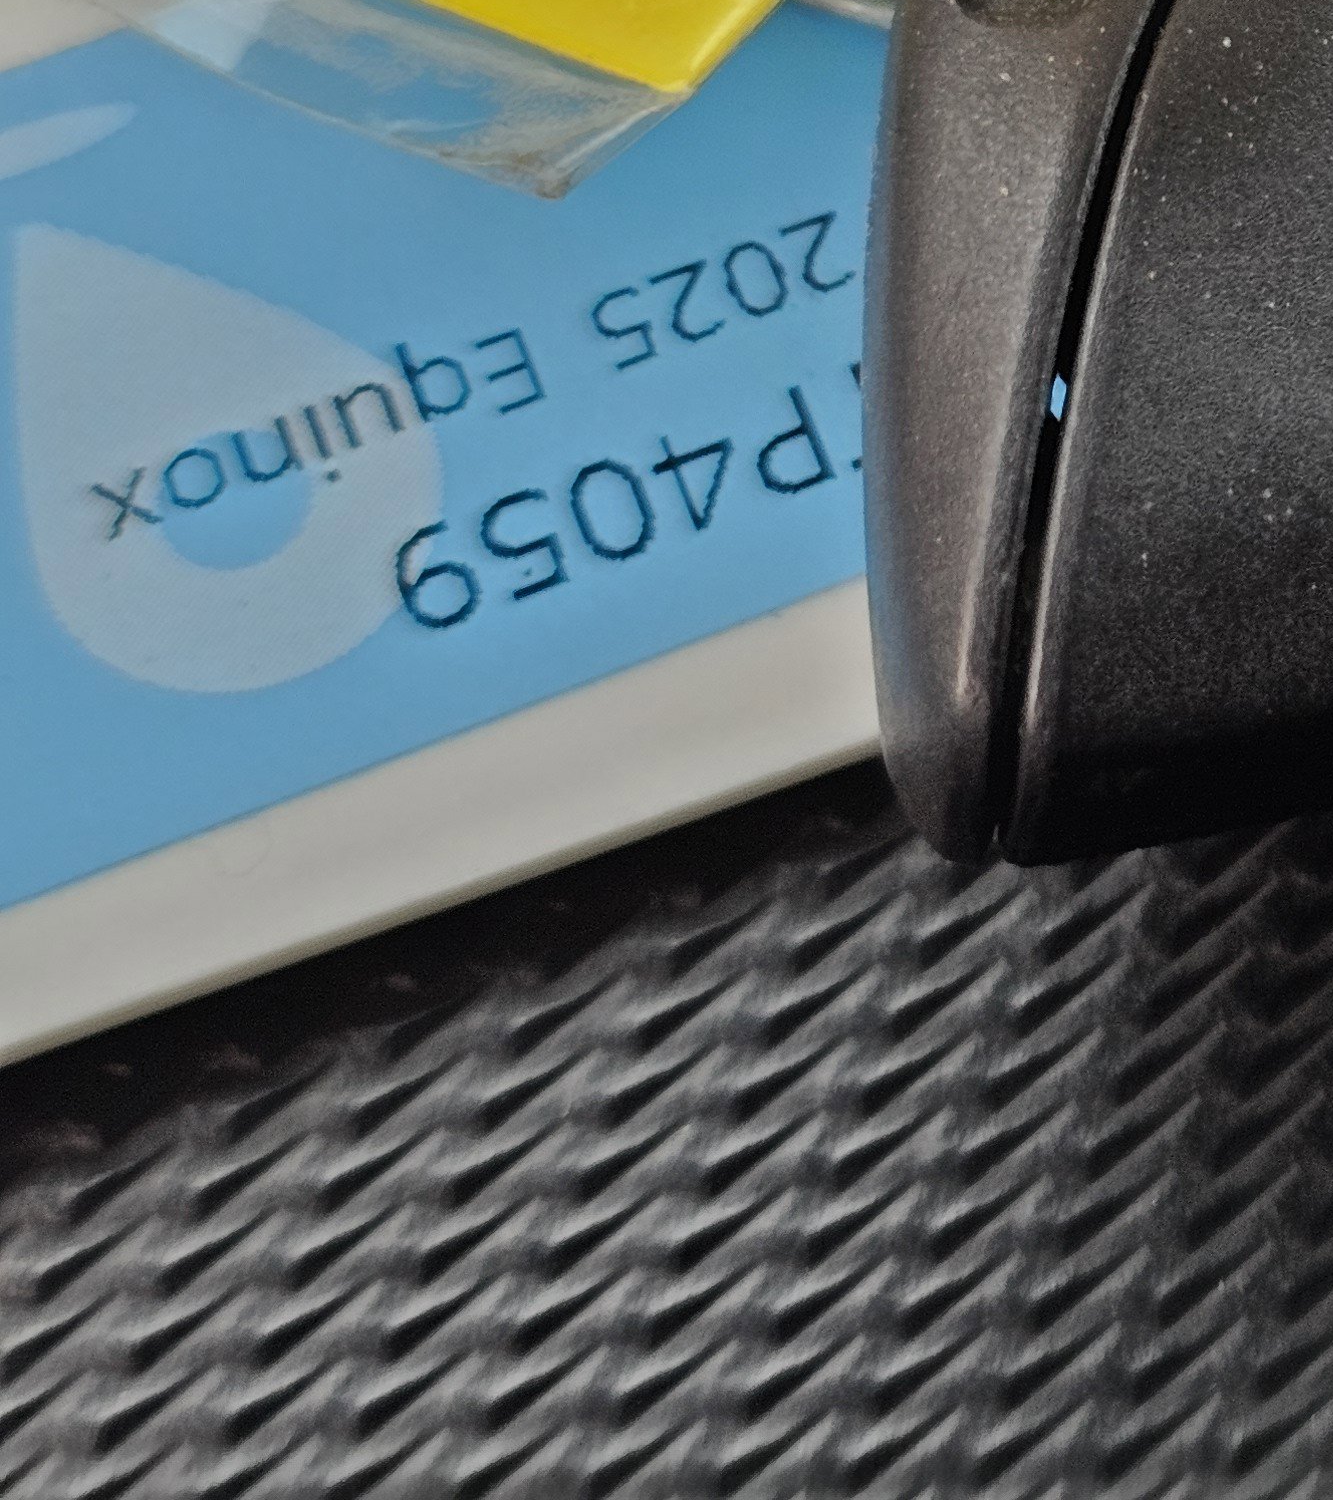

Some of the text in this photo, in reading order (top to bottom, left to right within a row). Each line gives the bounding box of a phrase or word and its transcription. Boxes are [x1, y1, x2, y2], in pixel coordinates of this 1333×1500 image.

[89, 209, 858, 542] 2025 Equinox
[392, 361, 863, 631] P4059
